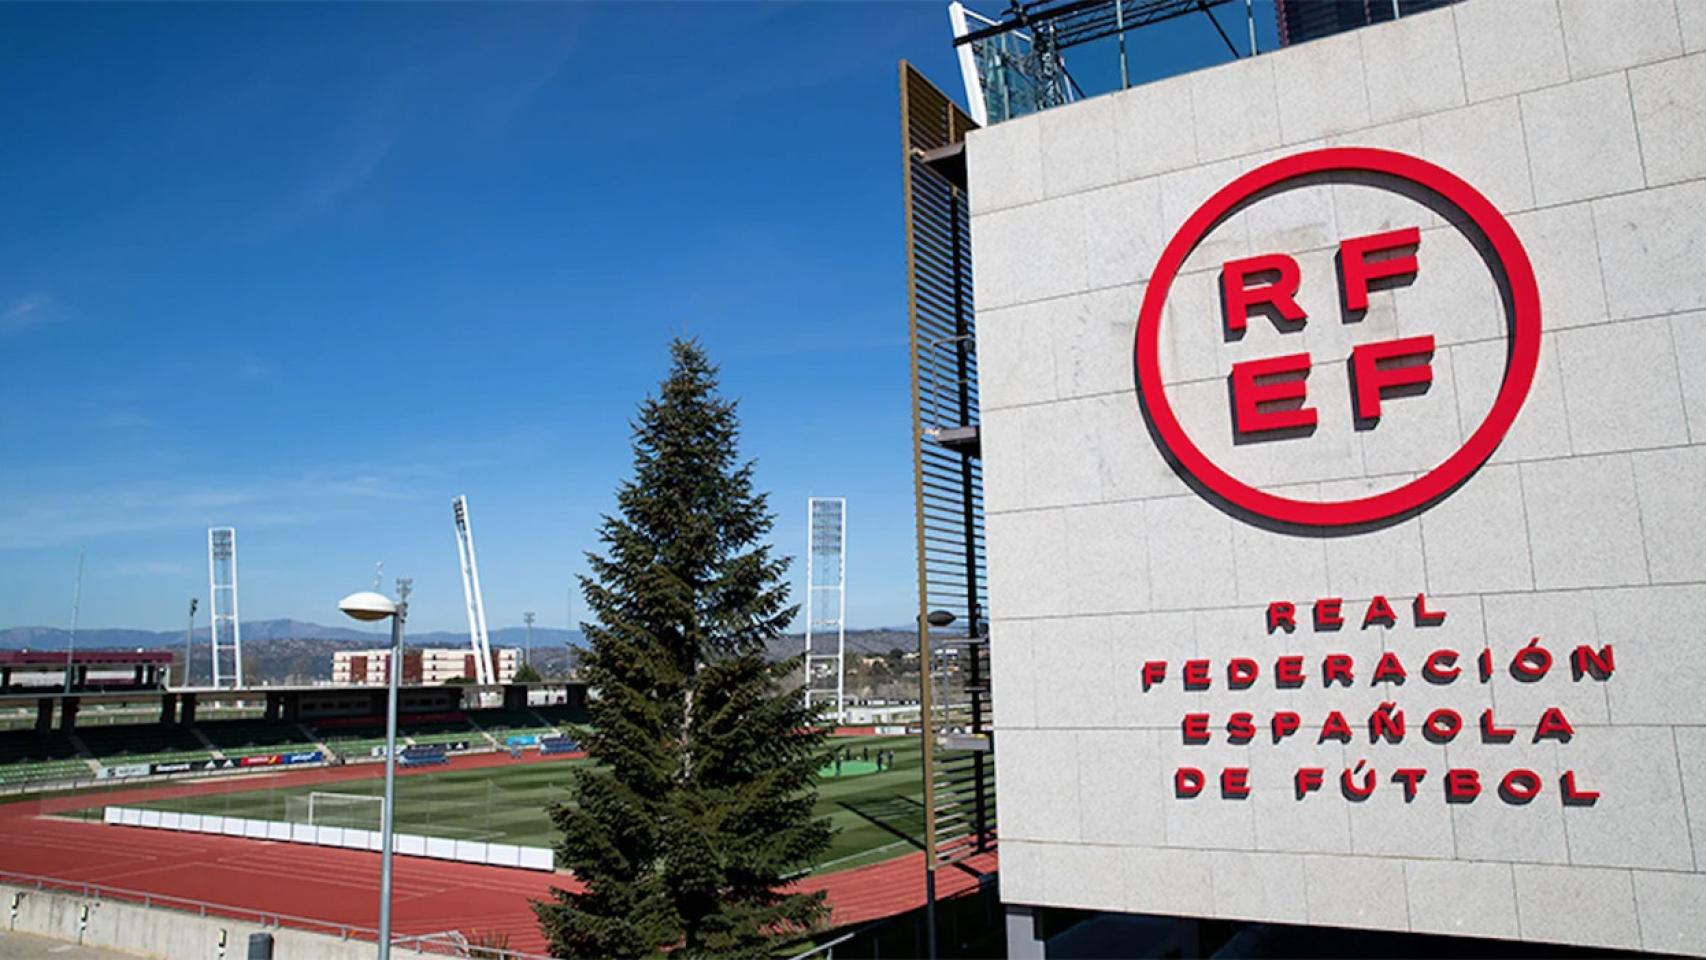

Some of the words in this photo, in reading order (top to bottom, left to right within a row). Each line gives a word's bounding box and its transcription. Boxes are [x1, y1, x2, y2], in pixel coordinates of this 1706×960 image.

[1266, 593, 1446, 633] REAL
[1143, 638, 1616, 691] FEDERACIÓN
[1183, 703, 1574, 743] ESPAÑOLA
[1175, 768, 1251, 799] DE
[1296, 760, 1600, 806] FÚTBOL
